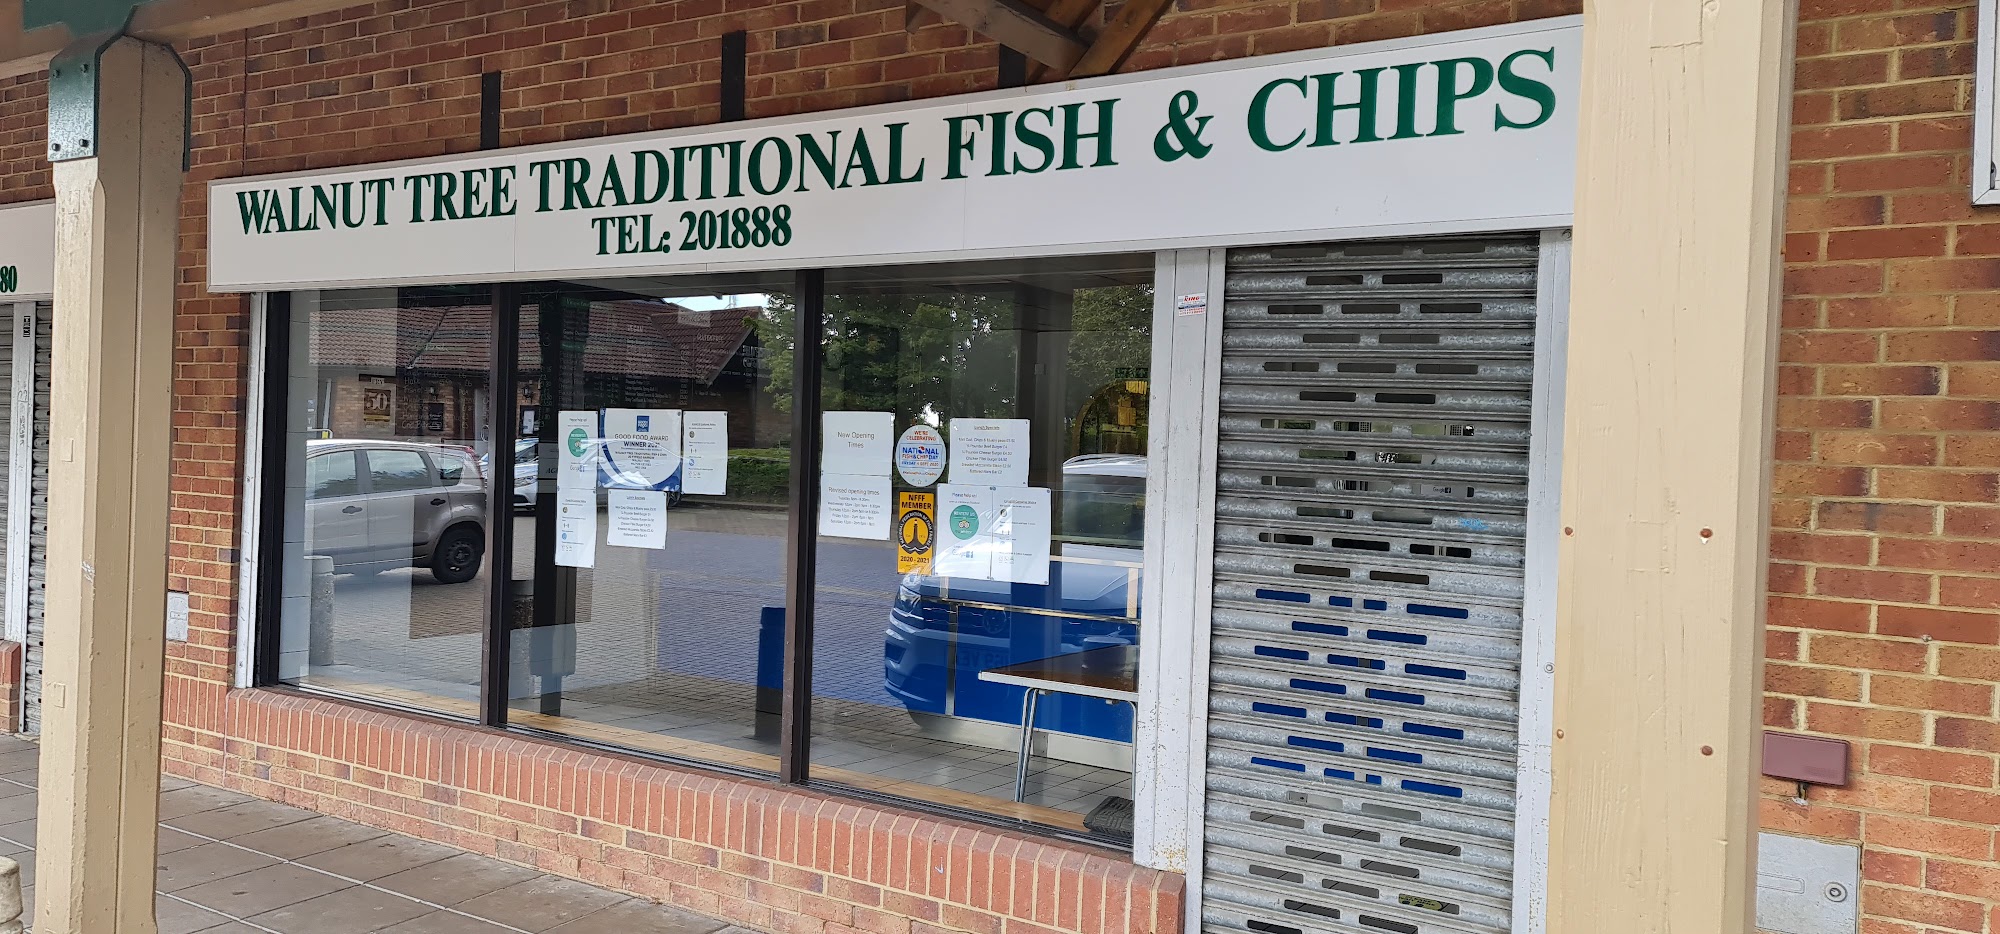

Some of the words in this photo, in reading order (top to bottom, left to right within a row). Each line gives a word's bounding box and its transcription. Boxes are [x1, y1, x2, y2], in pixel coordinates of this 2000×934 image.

[237, 177, 395, 235] WALNUT
[403, 164, 518, 224] TREE
[530, 120, 925, 214] TRADITIONAL
[941, 98, 1121, 181] FISH
[1154, 89, 1213, 163] &
[1247, 47, 1556, 153] CHIPS
[591, 213, 671, 255] TEL:
[678, 204, 793, 252] 201888
[851, 431, 875, 441] Opening
[848, 441, 865, 449] Times
[848, 488, 867, 496] opening
[902, 502, 932, 510] MEMBER
